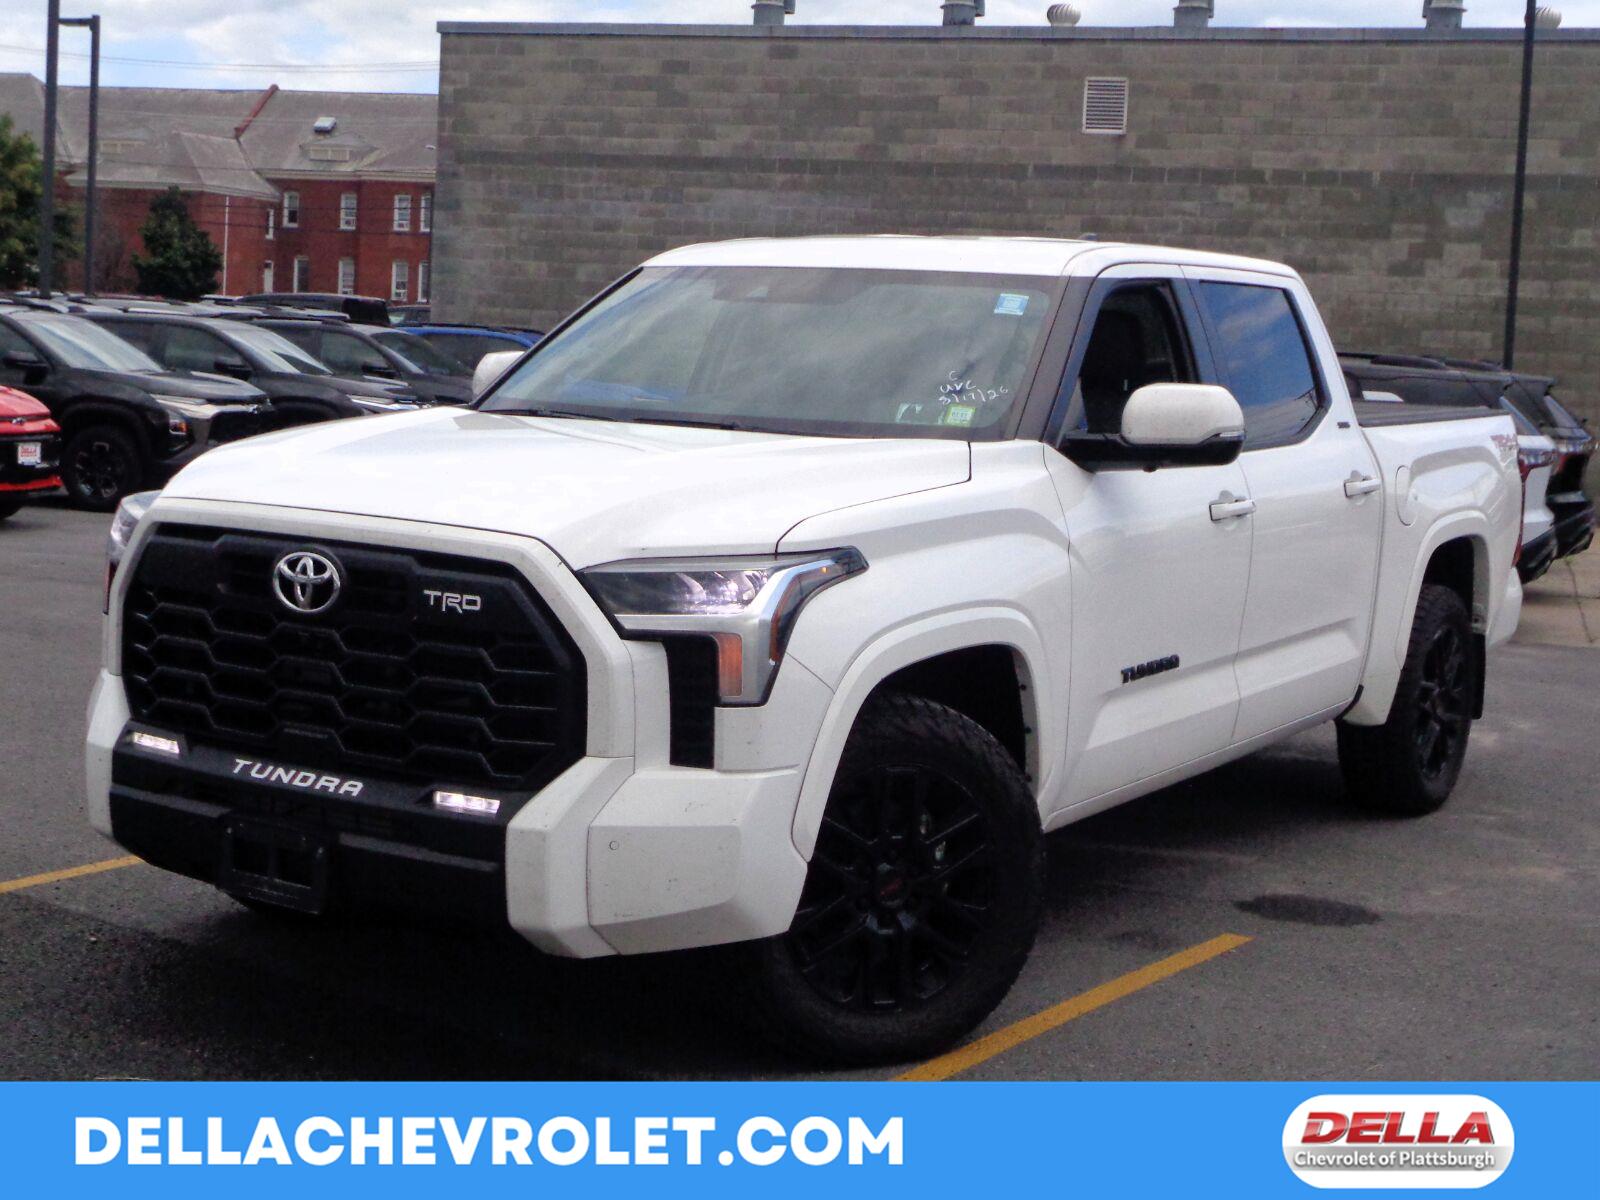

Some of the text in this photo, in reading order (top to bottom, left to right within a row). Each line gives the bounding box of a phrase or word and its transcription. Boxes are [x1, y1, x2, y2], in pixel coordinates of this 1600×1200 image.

[423, 589, 482, 614] TRD
[1120, 654, 1180, 684] TUNDRA
[232, 758, 364, 797] TUNDRA
